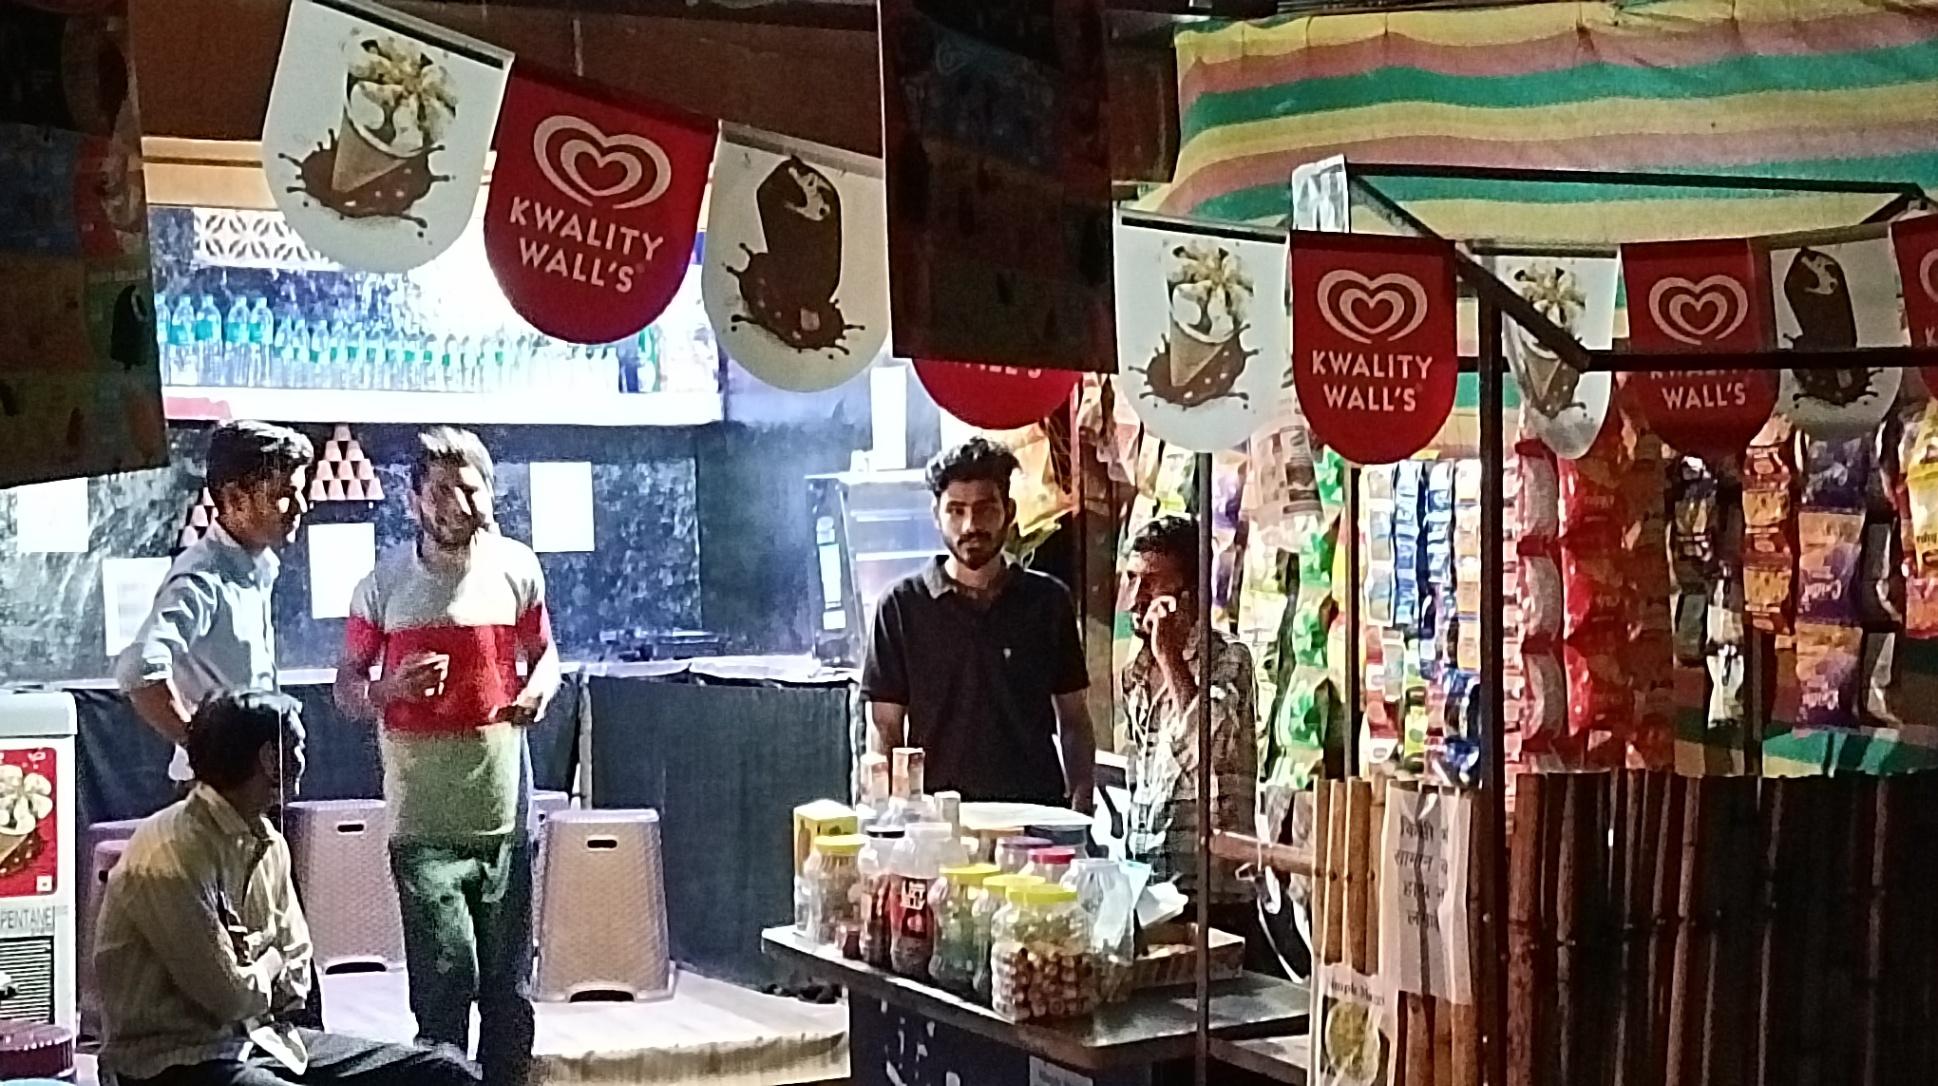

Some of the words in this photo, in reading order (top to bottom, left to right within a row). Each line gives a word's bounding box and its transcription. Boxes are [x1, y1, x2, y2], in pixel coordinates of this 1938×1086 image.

[509, 196, 664, 262] KWALITY
[518, 237, 634, 293] WALL'S
[1312, 349, 1433, 379] KWALITY
[1323, 383, 1416, 412] WALL'S
[1661, 382, 1746, 410] WALL'S
